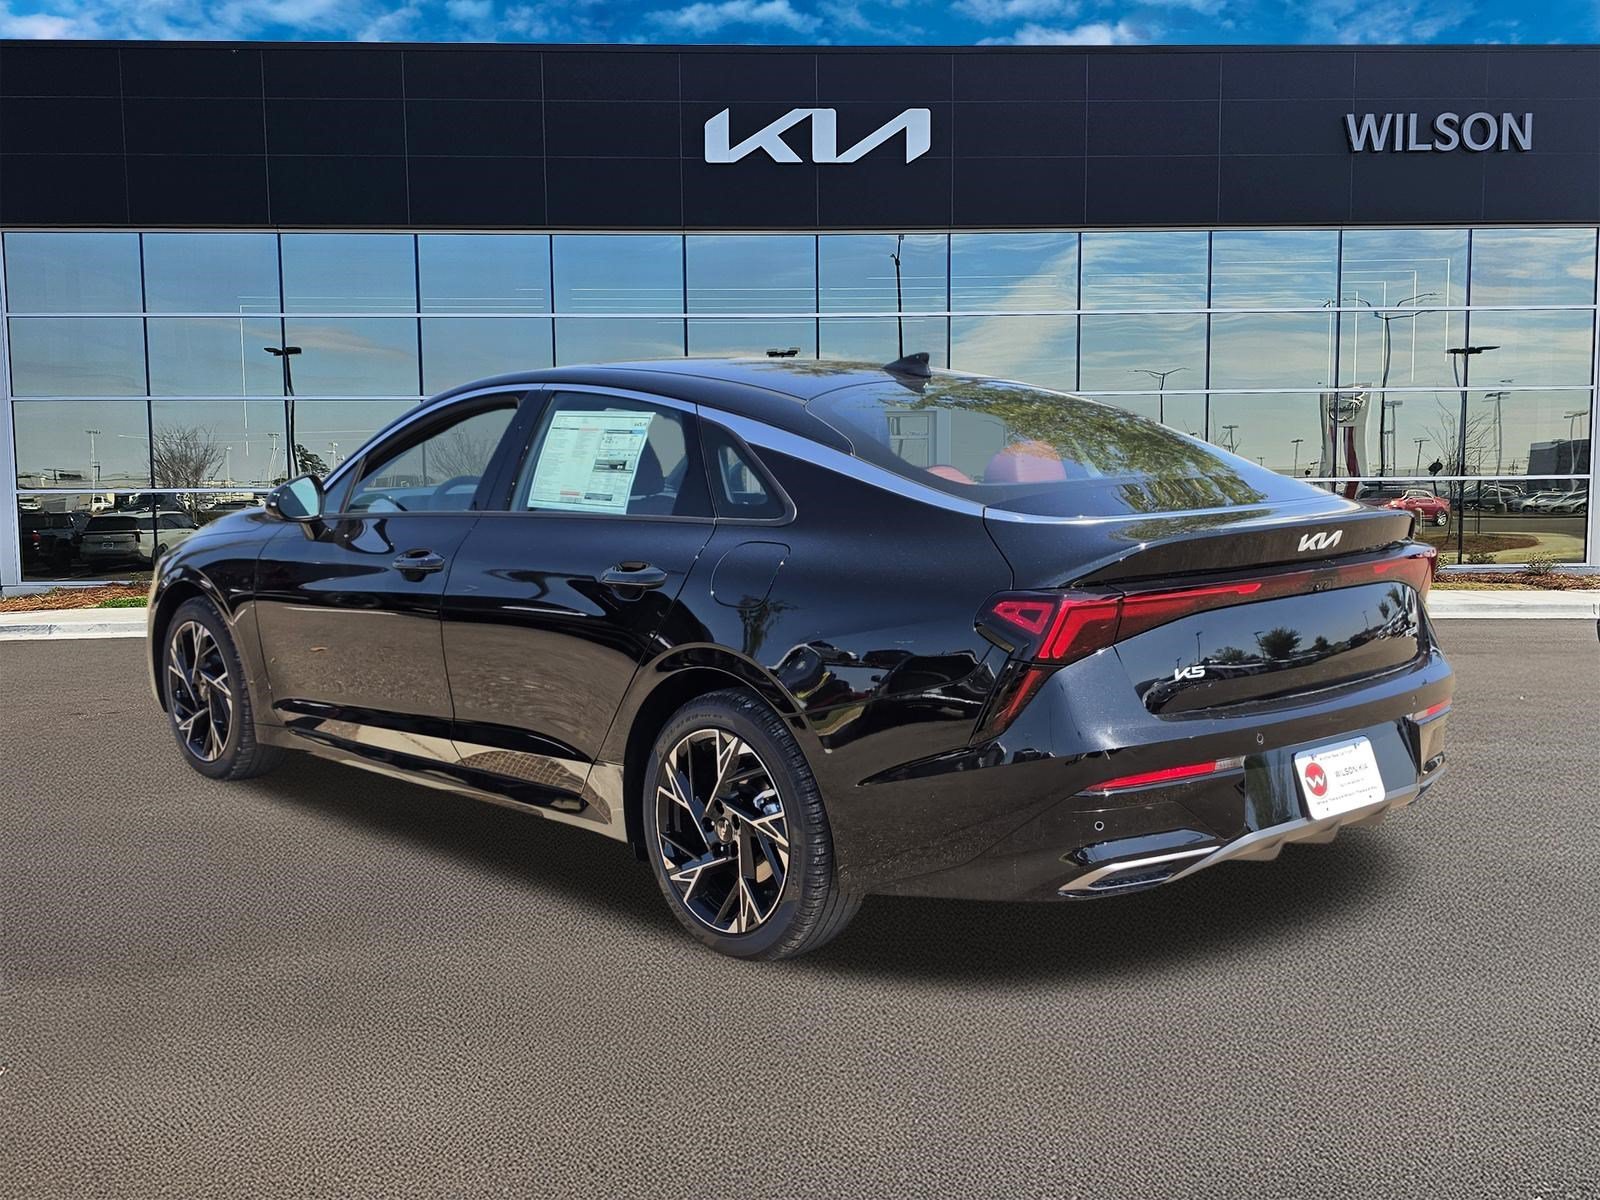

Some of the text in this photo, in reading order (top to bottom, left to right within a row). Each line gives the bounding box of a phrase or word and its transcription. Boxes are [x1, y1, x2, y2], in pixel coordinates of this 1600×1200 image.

[705, 108, 931, 164] KIA
[1345, 112, 1534, 152] WILSON
[1298, 530, 1343, 552] KIA
[1174, 665, 1206, 681] K5
